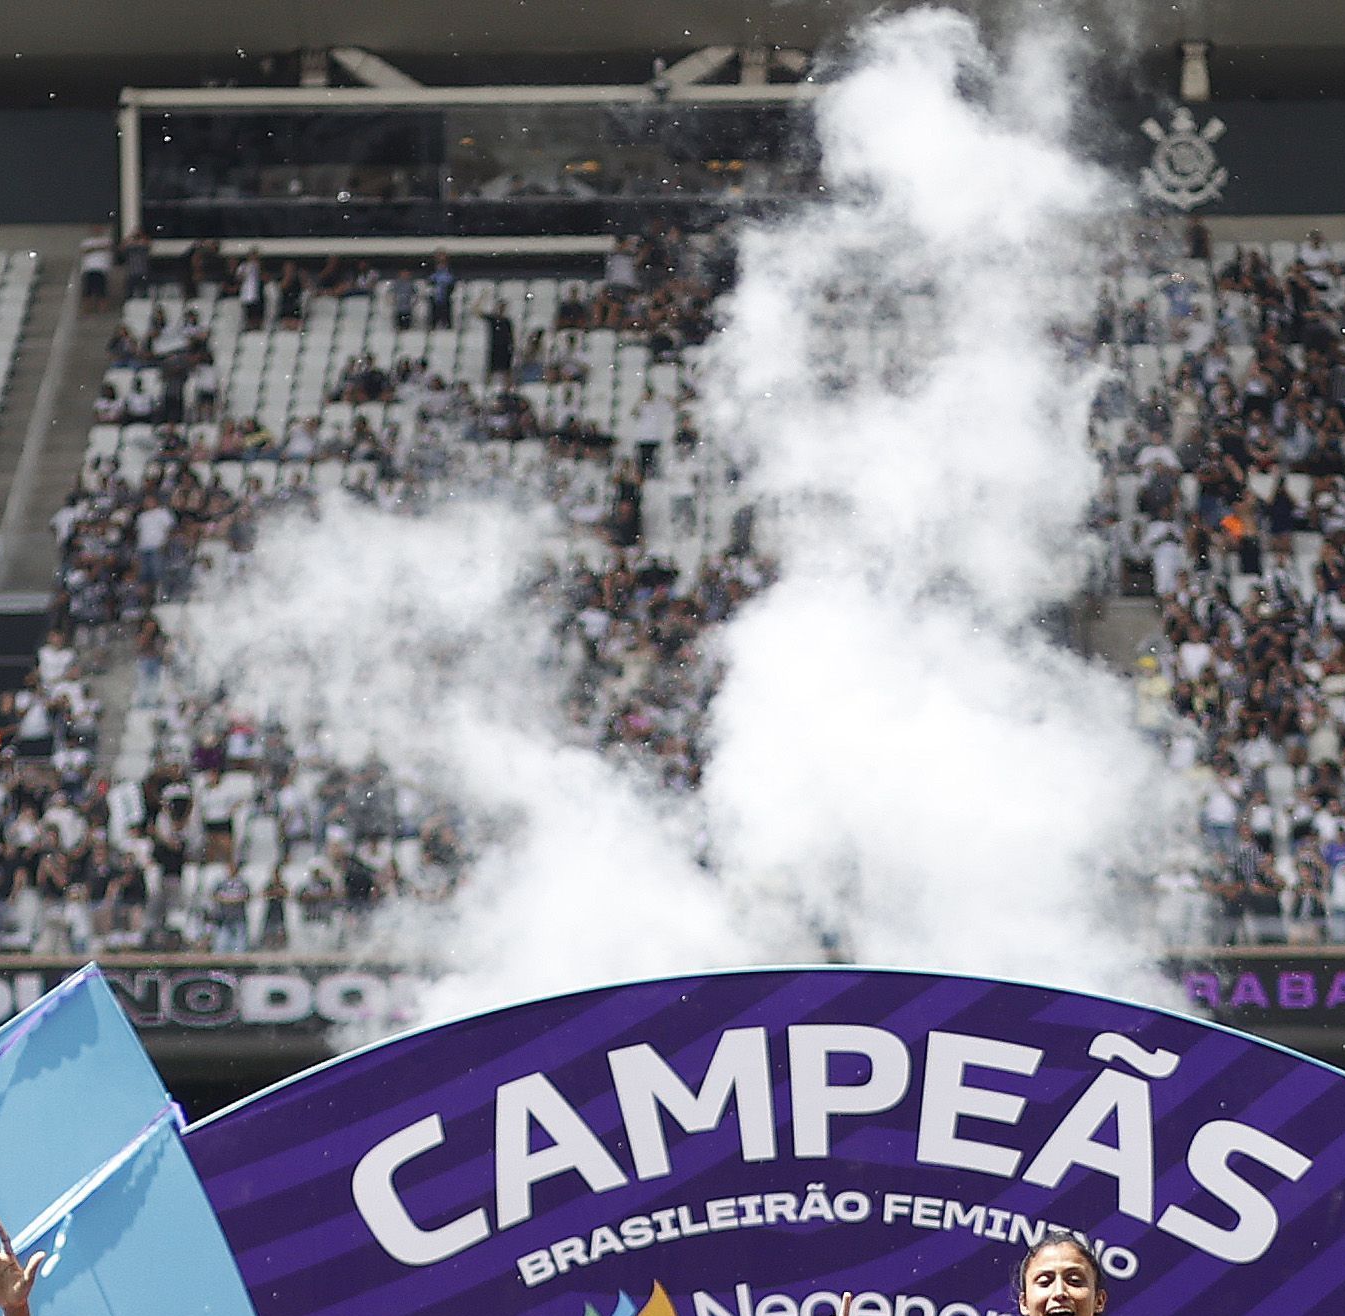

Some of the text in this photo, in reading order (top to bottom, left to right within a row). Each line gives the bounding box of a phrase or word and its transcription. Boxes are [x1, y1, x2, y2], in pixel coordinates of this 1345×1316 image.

[351, 1024, 1313, 1267] CAMPEÃS
[516, 1183, 1140, 1288] BRASILEIRÃO FEMINO
